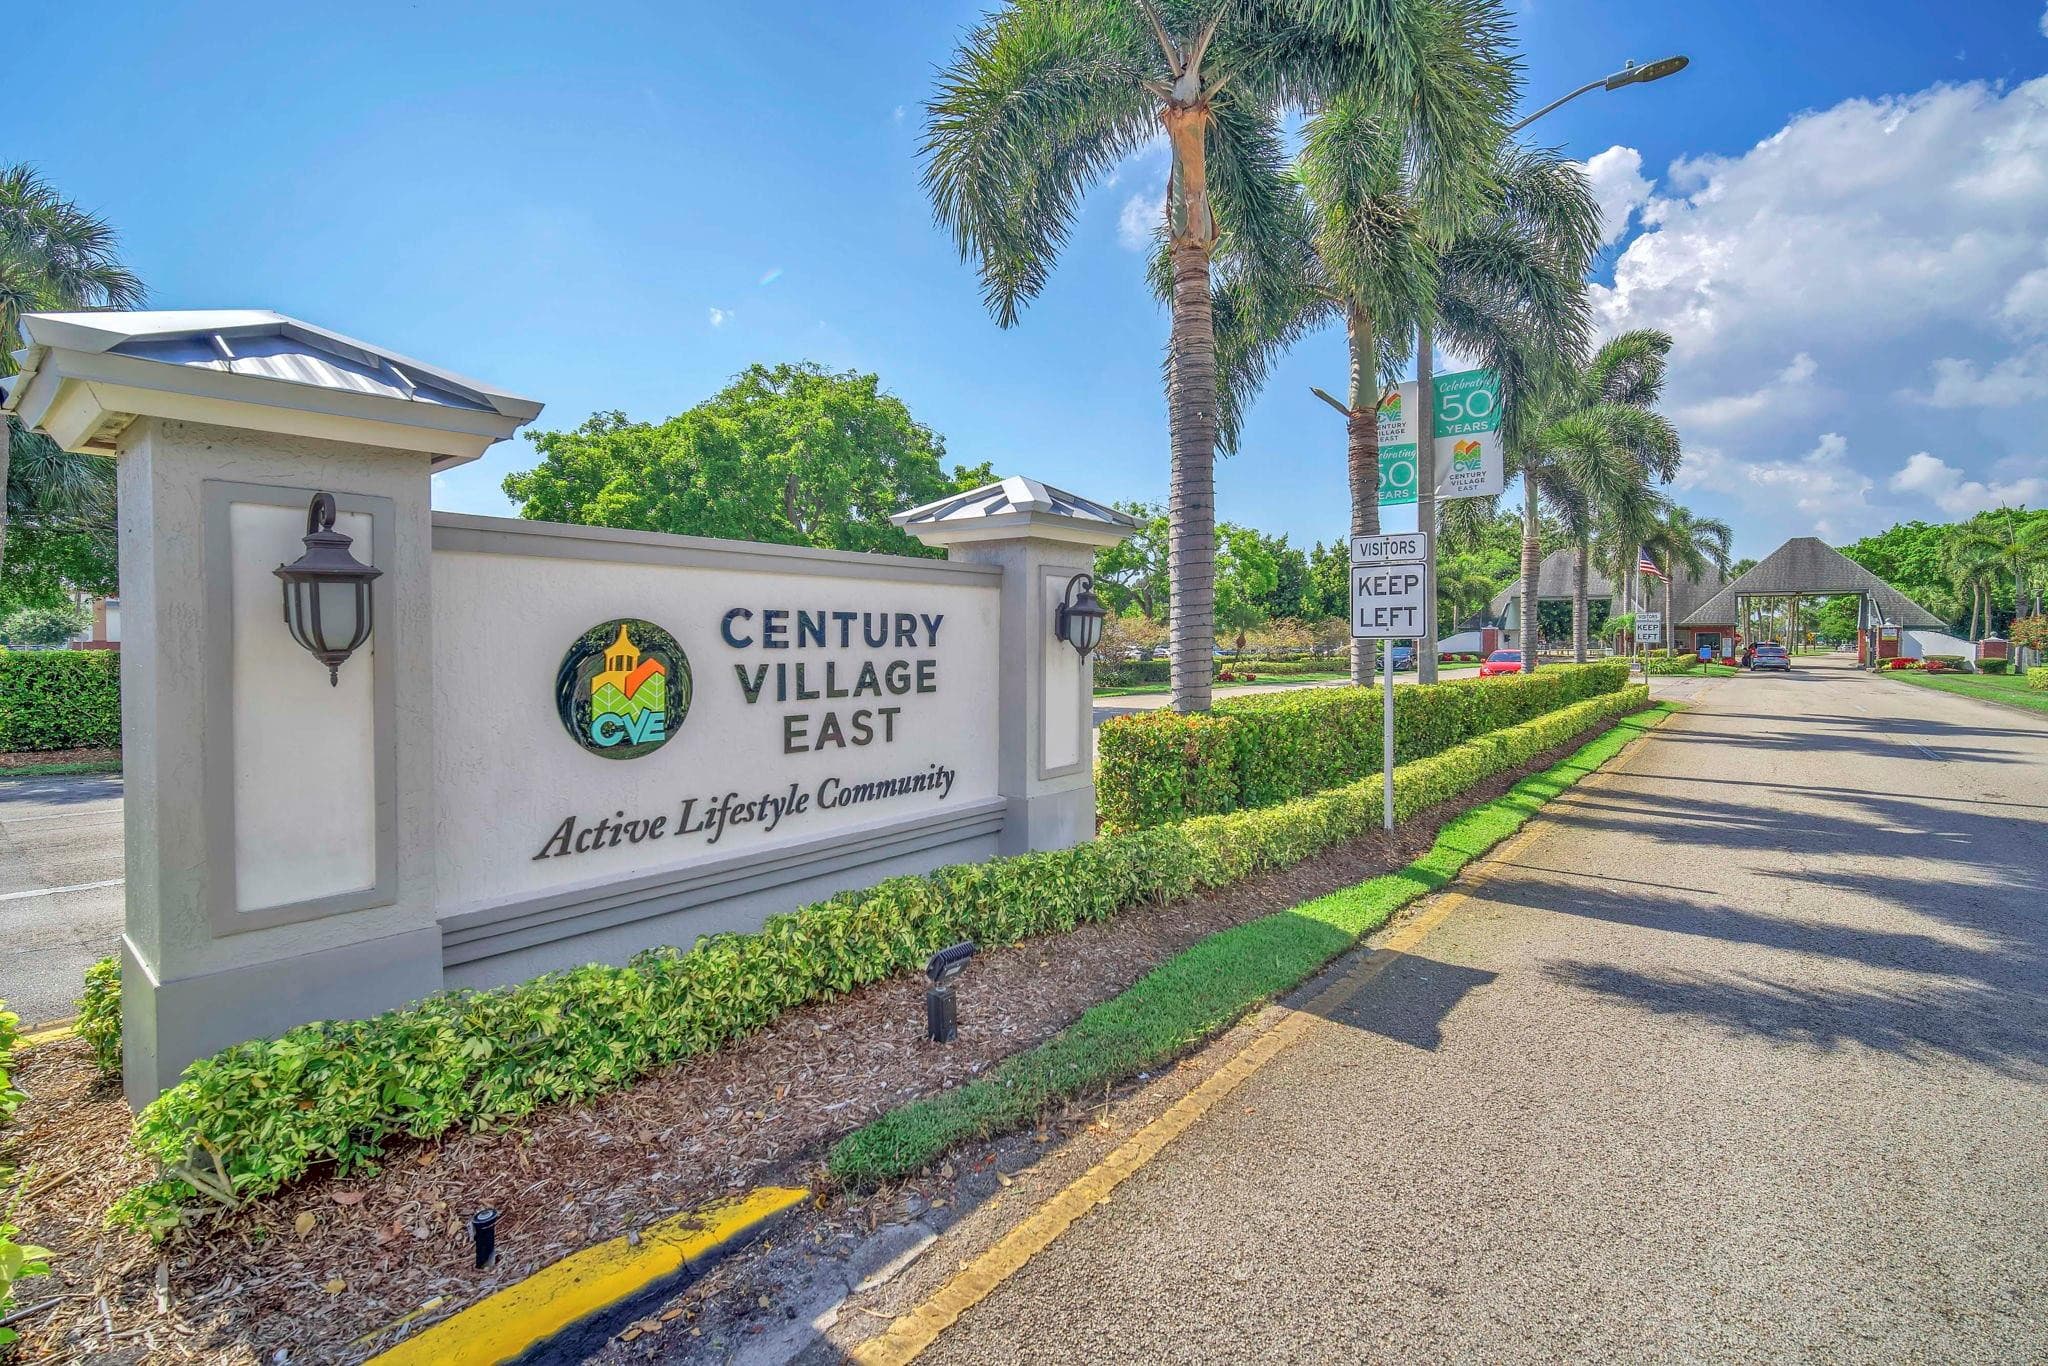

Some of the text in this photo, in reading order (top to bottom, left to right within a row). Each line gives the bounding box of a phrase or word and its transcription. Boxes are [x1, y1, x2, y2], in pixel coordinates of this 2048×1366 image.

[1440, 390, 1494, 421] 50
[1378, 429, 1406, 437] ILLAGE
[1446, 421, 1489, 433] YEARS
[1449, 471, 1487, 480] CENTURY
[1451, 478, 1485, 486] VILLAGE
[1378, 490, 1409, 500] EARS
[1360, 541, 1416, 556] VISITORS
[1359, 575, 1419, 596] KEEP
[1361, 607, 1417, 627] LEFT
[720, 608, 944, 648] CENTURY
[734, 660, 937, 703] VILLAGE
[591, 707, 665, 747] CVE
[783, 707, 901, 754] EAST
[532, 764, 955, 860] Active Lifestyle Community
